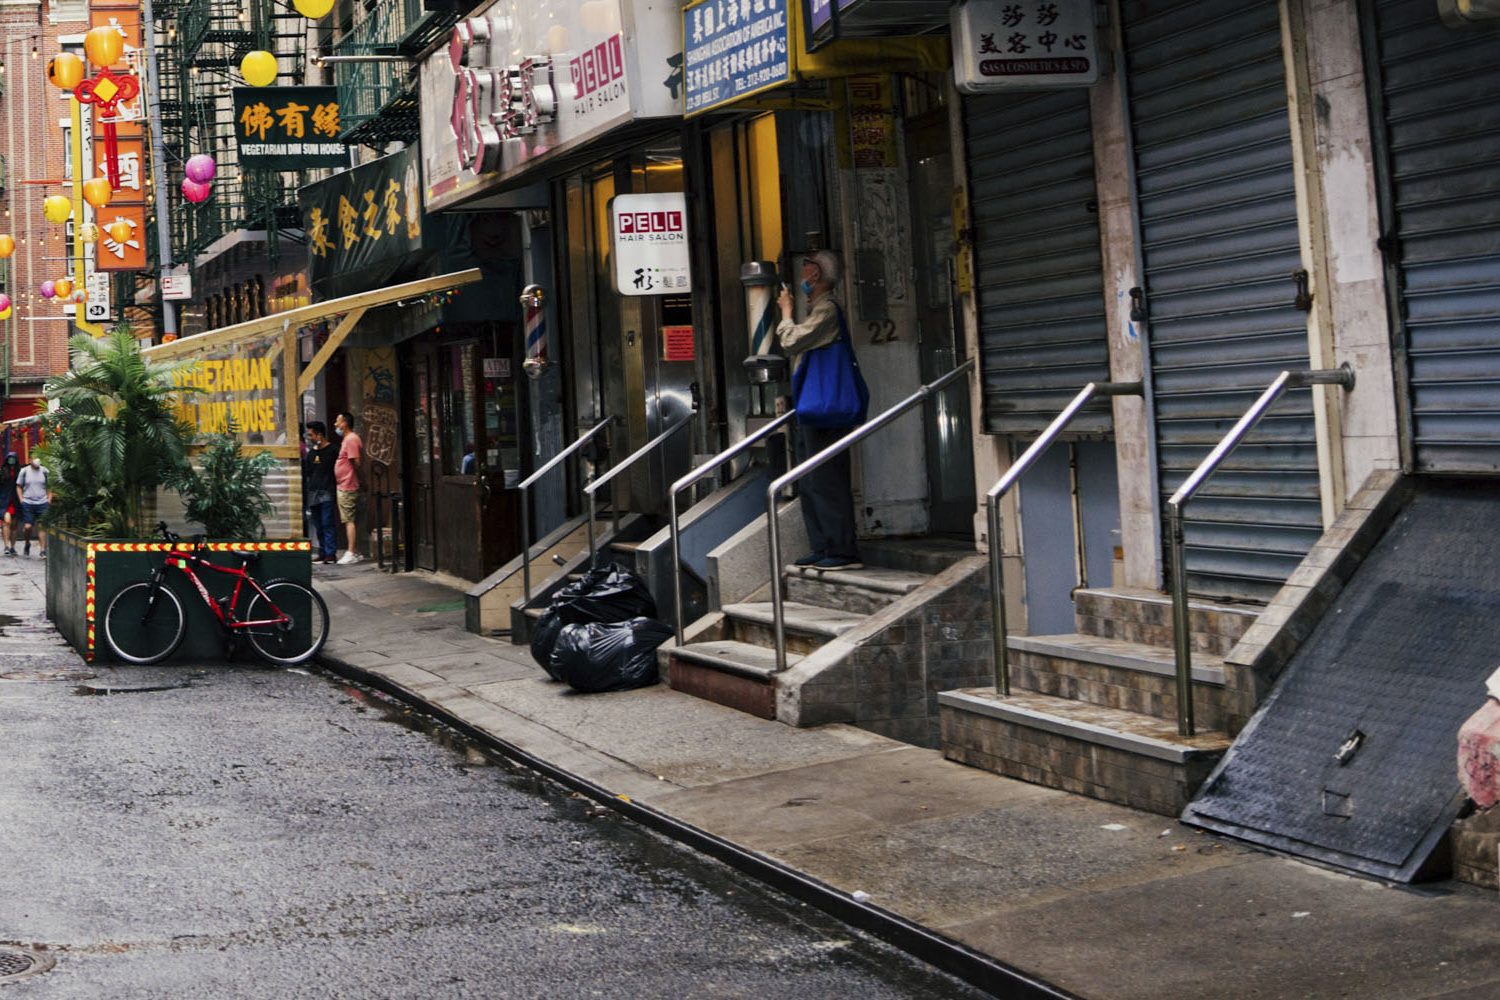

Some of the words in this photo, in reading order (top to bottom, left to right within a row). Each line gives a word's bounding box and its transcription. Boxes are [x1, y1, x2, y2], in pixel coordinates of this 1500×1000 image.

[1001, 3, 1061, 28] 莎莎
[978, 30, 1088, 55] 美容中心
[571, 35, 622, 99] PELL
[982, 62, 1006, 74] SASA
[1006, 60, 1060, 73] COSMETICS
[1060, 61, 1069, 71] &
[1071, 60, 1088, 71] SPA
[574, 98, 596, 119] HAIR
[597, 81, 627, 107] SALON
[239, 101, 343, 142] 佛有緣
[241, 143, 287, 156] VEGETARIAN
[287, 143, 302, 155] DIM
[302, 143, 319, 155] SUM
[320, 143, 346, 155] HOUSE
[309, 178, 402, 259] 素食之家
[619, 212, 682, 233] PELL
[619, 233, 644, 242] HAIR
[649, 233, 684, 241] SALON
[90, 306, 105, 316] 34
[867, 319, 899, 345] 22
[486, 359, 509, 372] ATM
[229, 398, 276, 434] HOUSE
